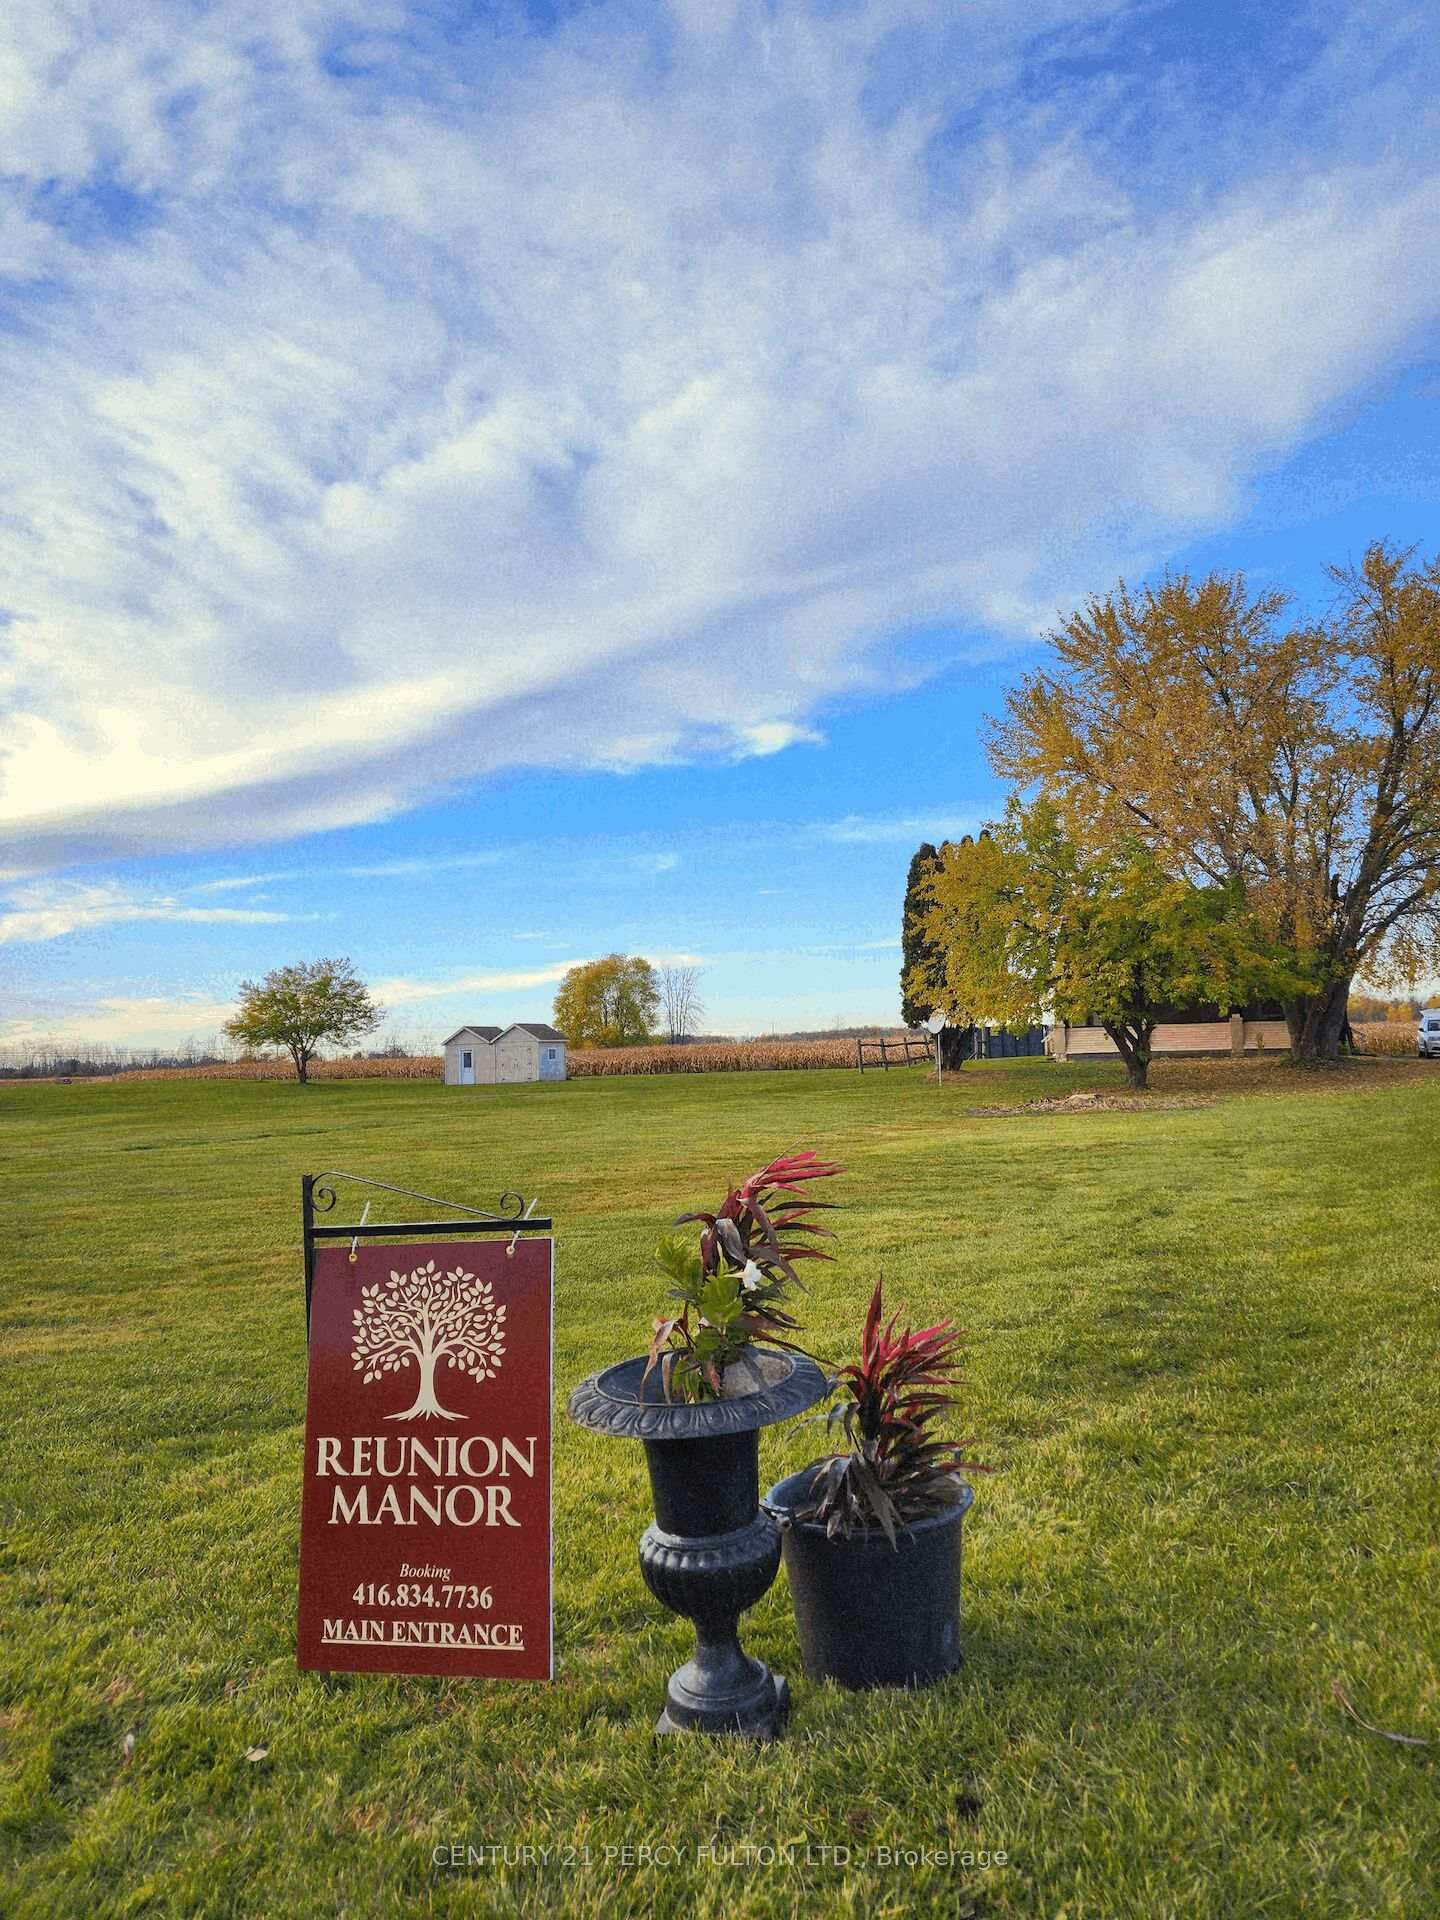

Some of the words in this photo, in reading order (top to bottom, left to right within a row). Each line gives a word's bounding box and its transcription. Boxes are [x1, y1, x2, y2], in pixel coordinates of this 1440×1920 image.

[316, 1436, 537, 1477] REUNION
[327, 1484, 521, 1527] MANOR
[399, 1563, 451, 1582] Booking
[352, 1583, 493, 1609] 416.834.7736
[322, 1619, 385, 1641] MAIN
[391, 1621, 524, 1646] ENTRANCE
